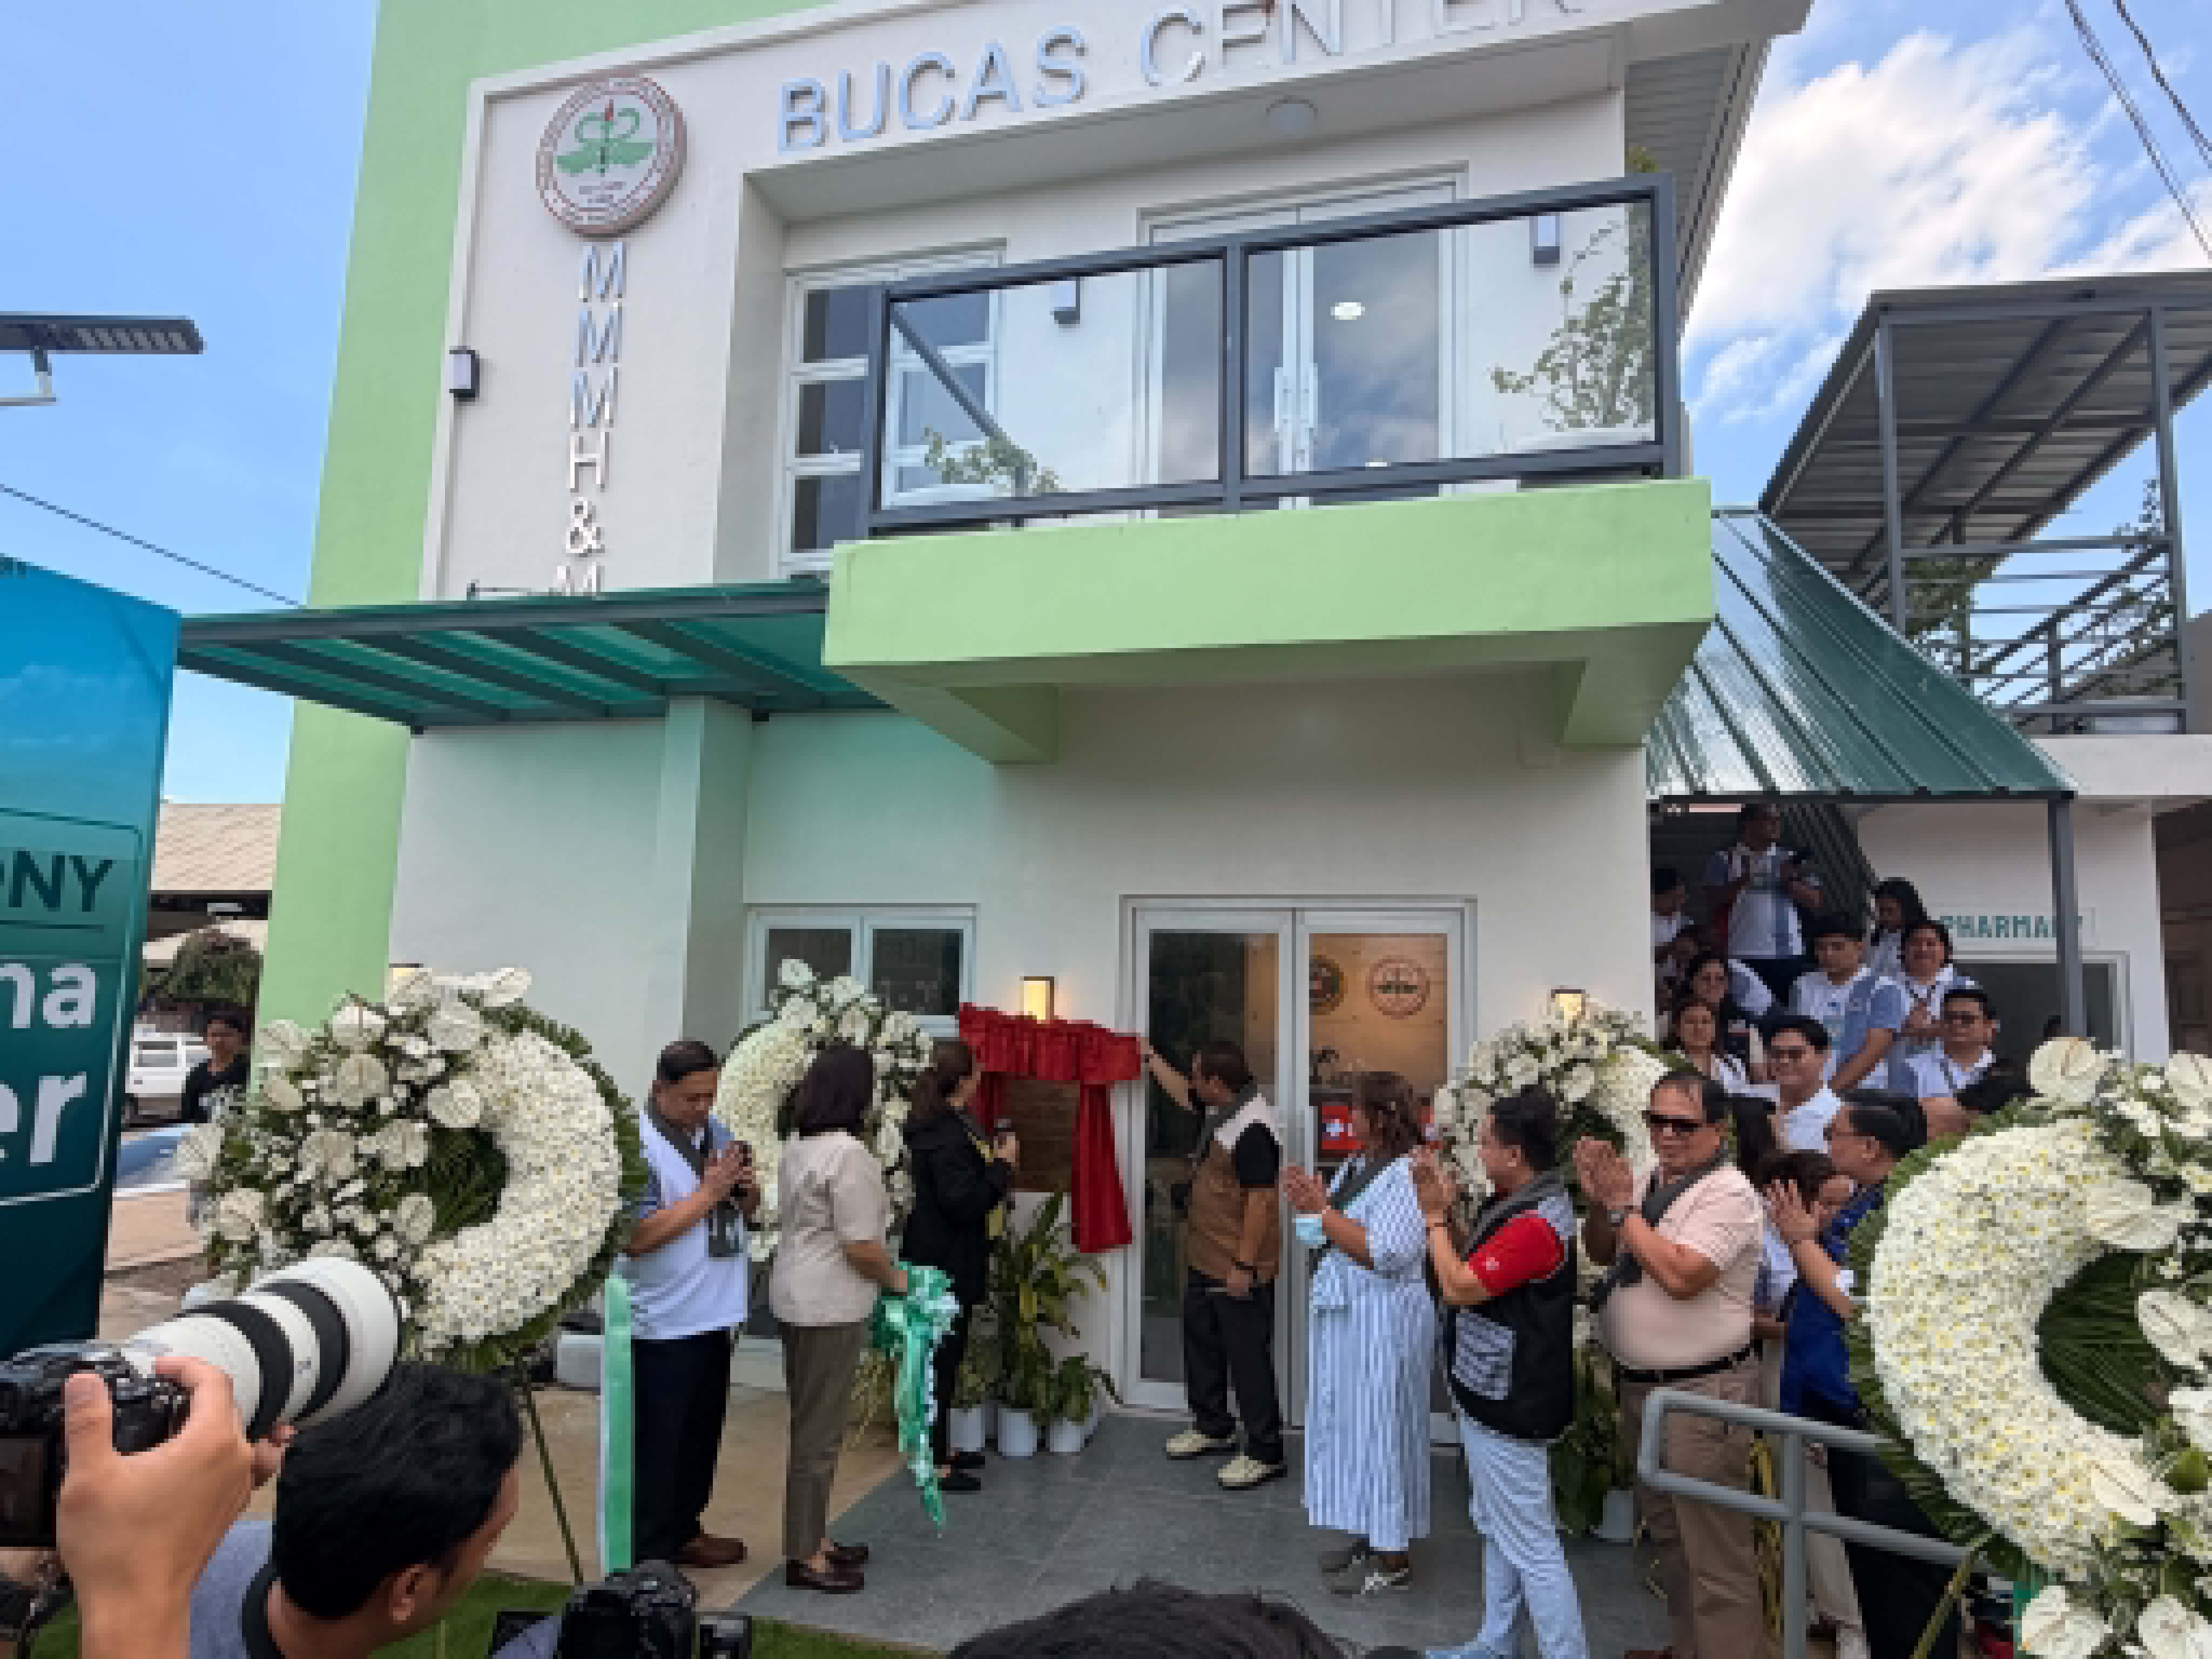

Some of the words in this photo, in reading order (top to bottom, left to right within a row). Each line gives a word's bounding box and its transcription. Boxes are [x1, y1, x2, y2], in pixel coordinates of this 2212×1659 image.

[778, 26, 1088, 156] BUCAS
[0, 850, 113, 913] NY
[1939, 915, 2082, 939] PHARMA
